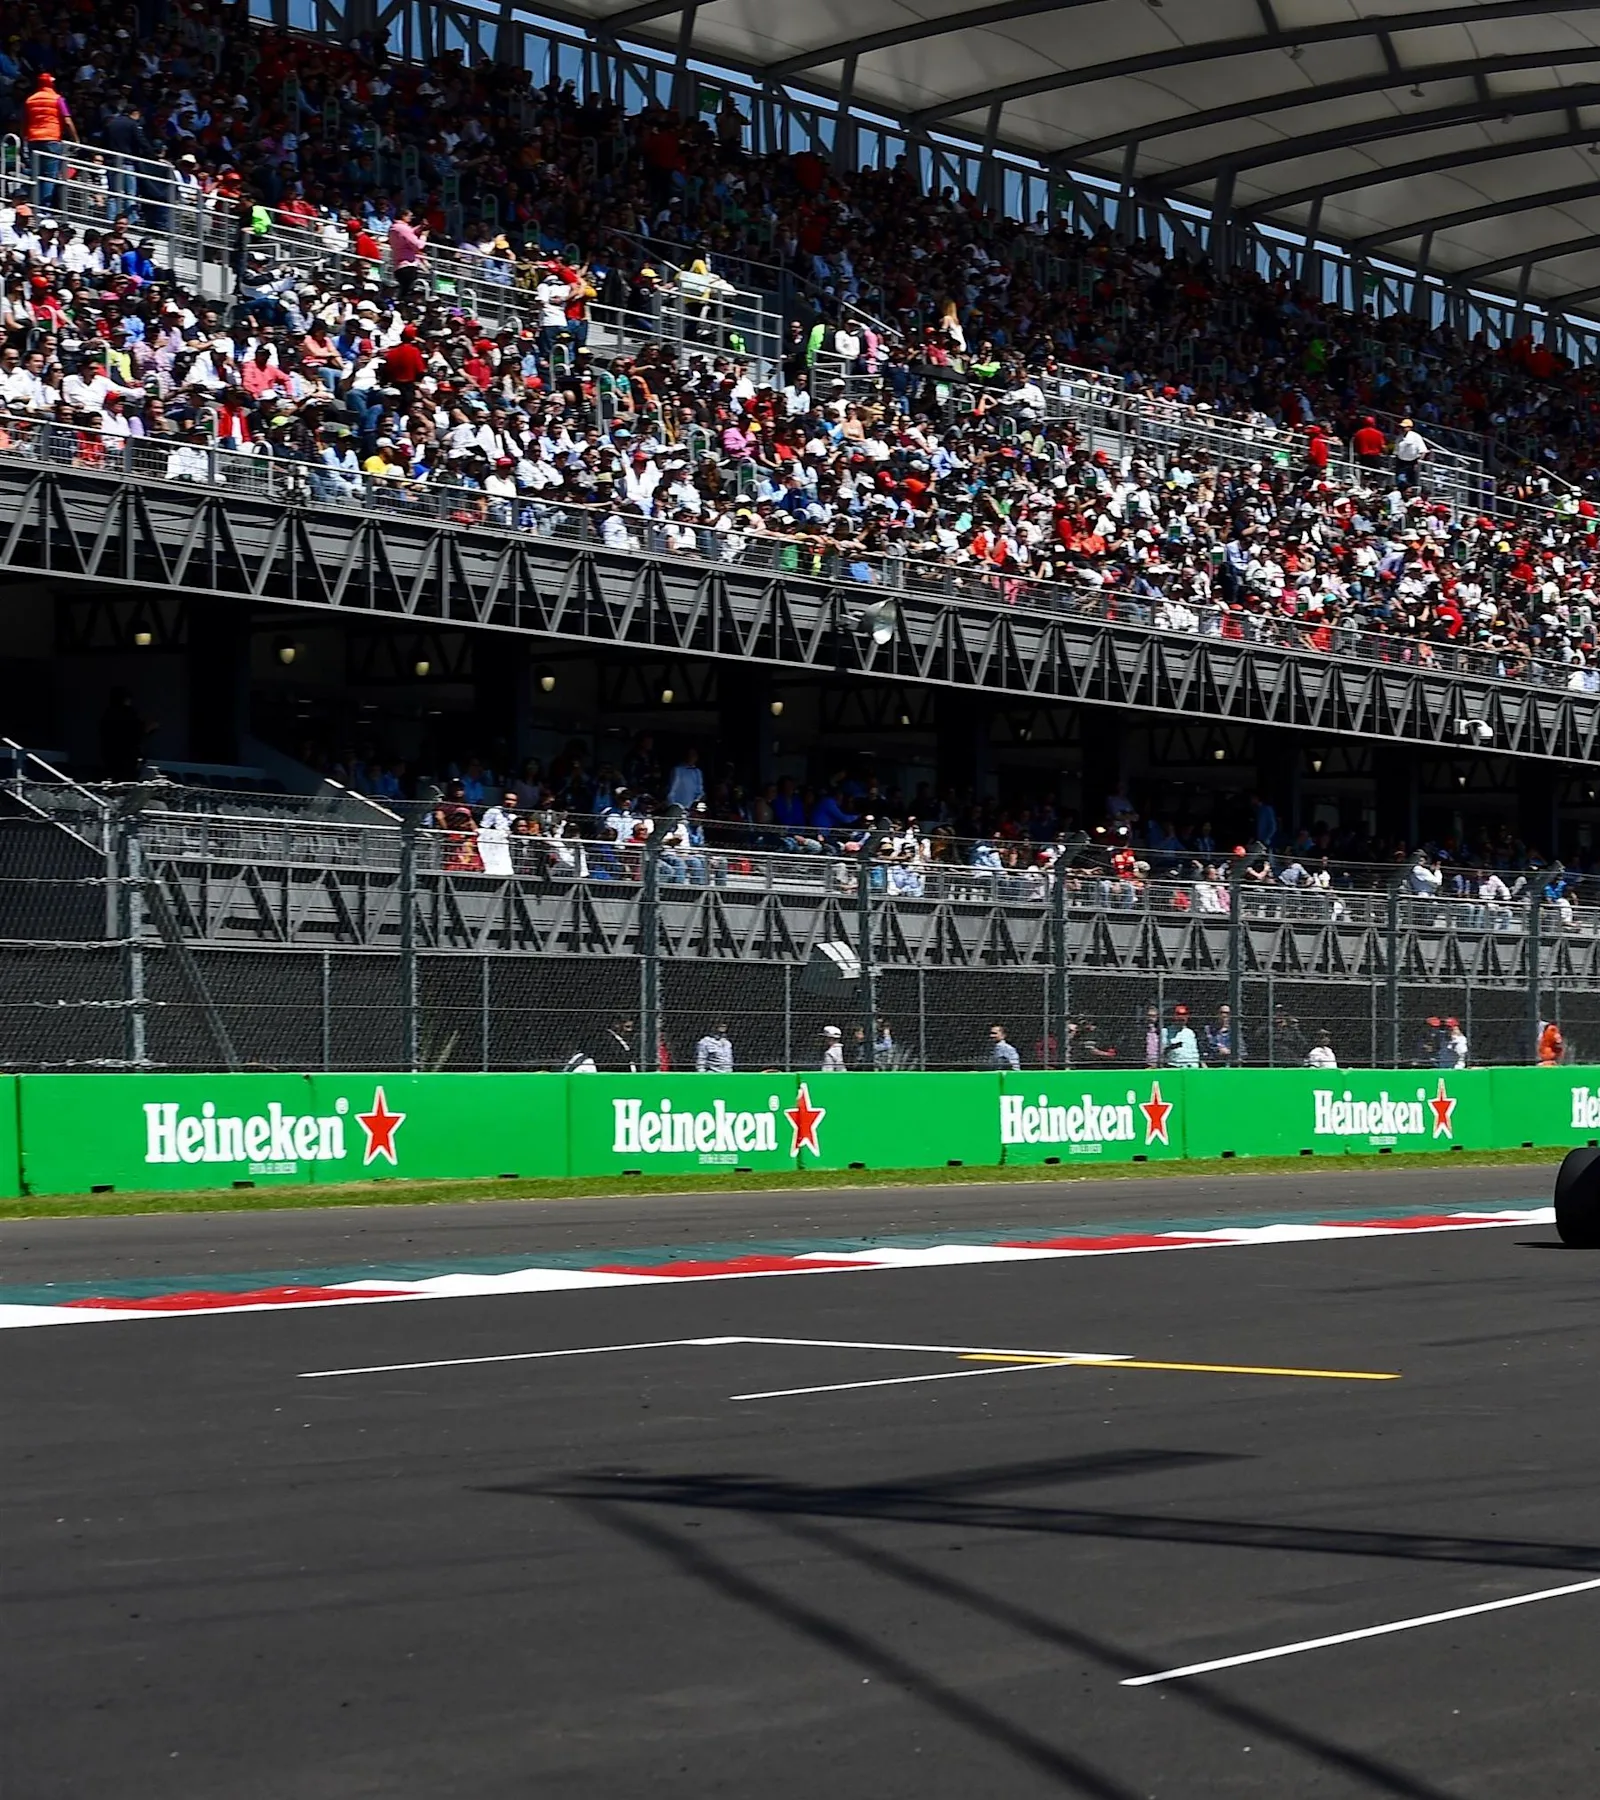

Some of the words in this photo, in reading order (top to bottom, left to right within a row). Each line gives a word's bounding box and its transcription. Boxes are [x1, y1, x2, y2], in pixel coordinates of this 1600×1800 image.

[144, 1102, 347, 1164] Heineken
[612, 1098, 778, 1153] Heineken
[1000, 1094, 1136, 1144] Heineken
[1313, 1090, 1426, 1136] Heineken
